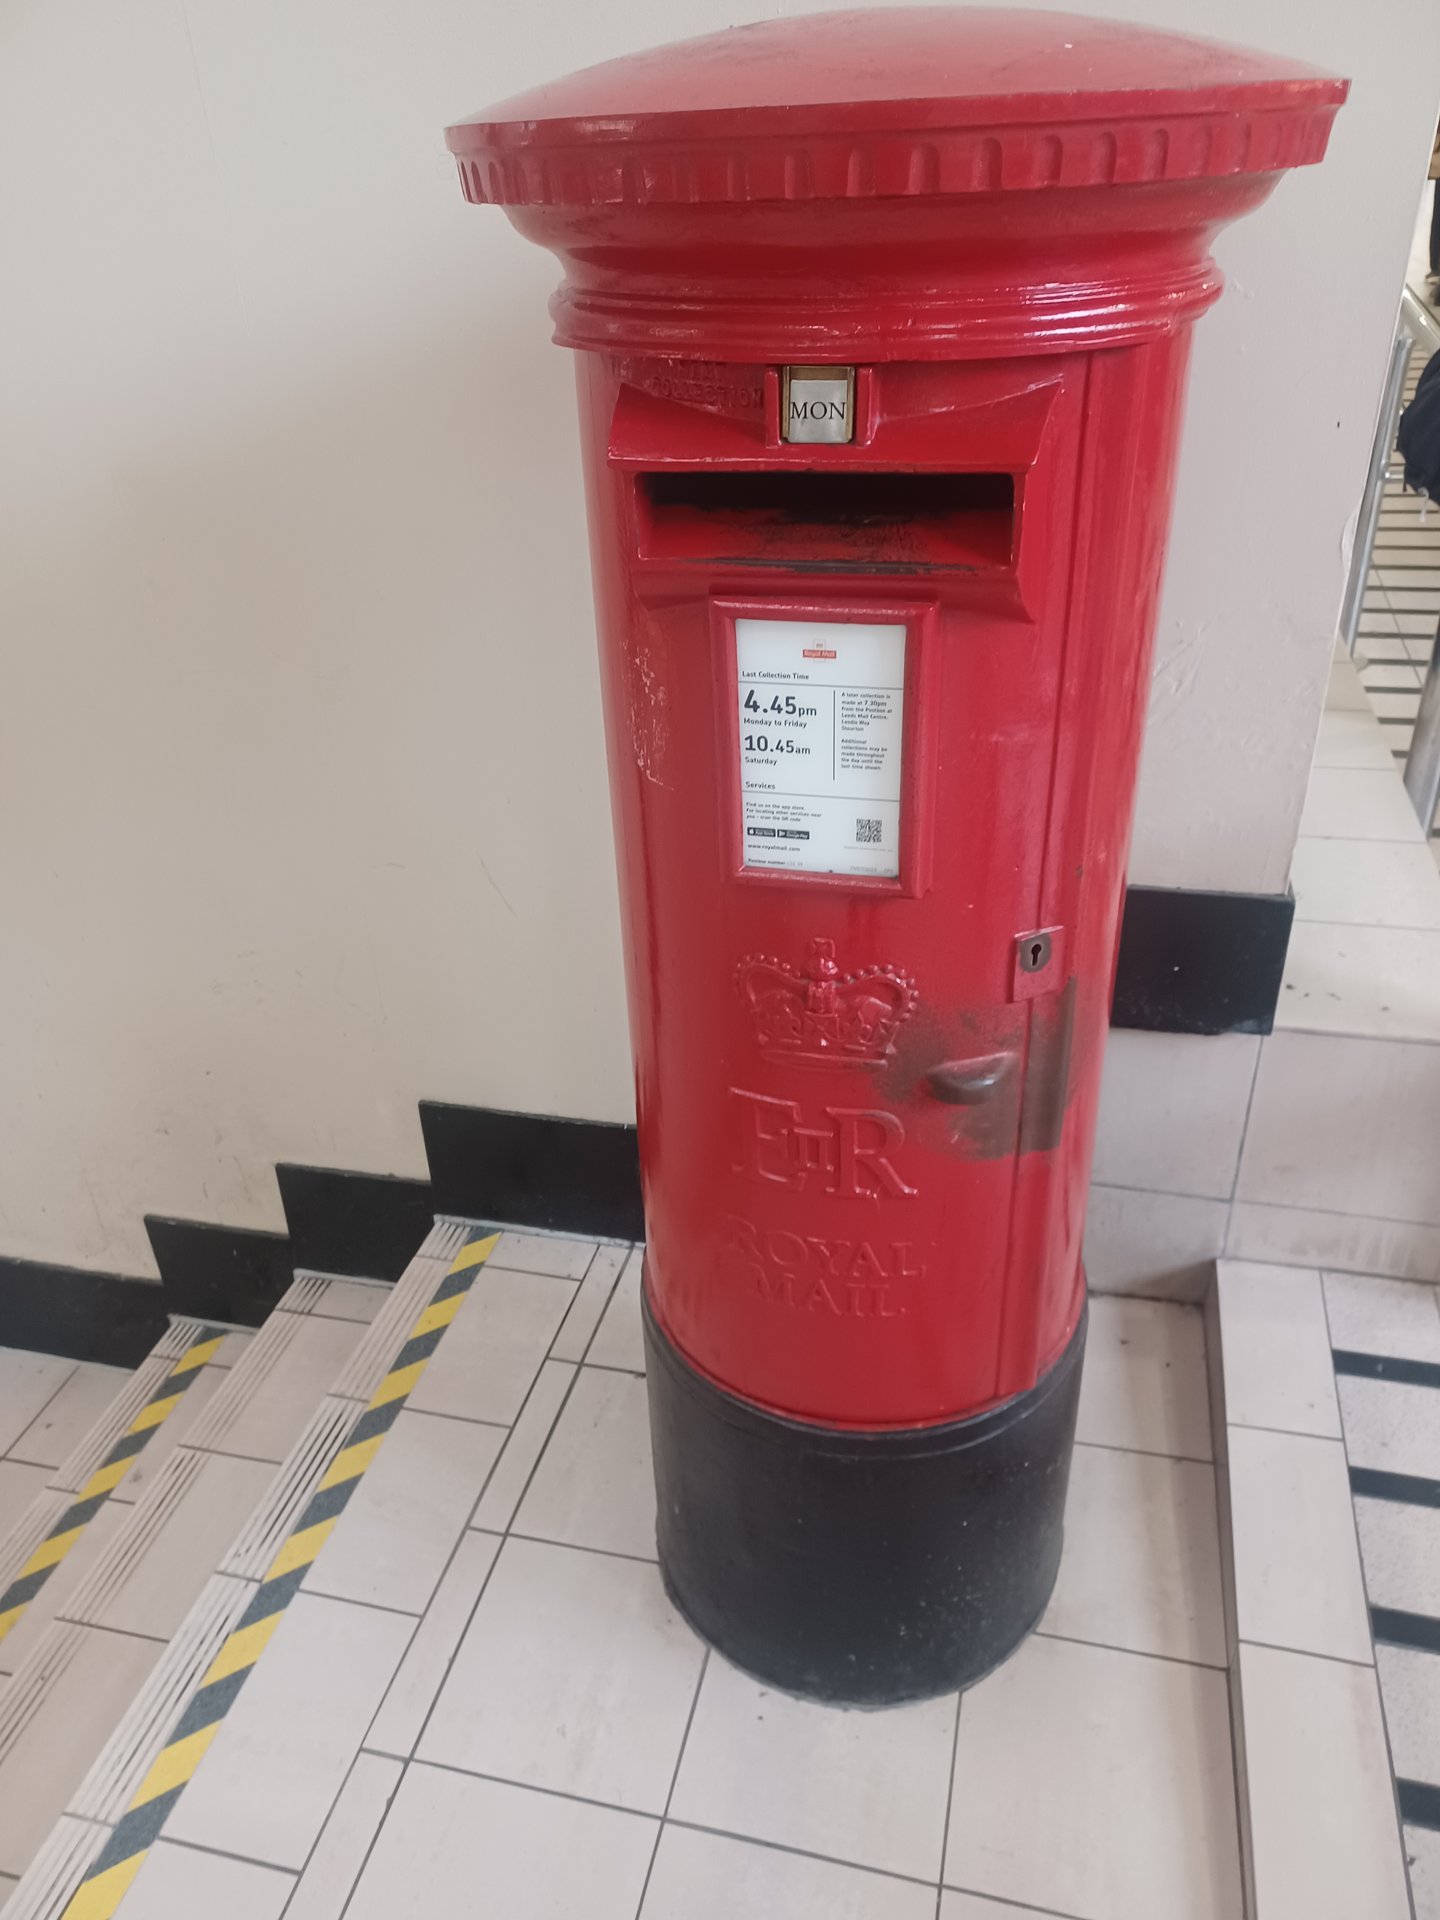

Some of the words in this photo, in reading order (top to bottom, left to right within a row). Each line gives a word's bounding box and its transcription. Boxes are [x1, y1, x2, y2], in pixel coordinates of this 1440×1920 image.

[790, 401, 846, 420] MON
[804, 650, 820, 658] Royal
[822, 650, 835, 658] Mail
[758, 671, 790, 679] Collection
[744, 689, 817, 718] 4.45pm
[743, 717, 772, 727] Monday
[774, 719, 782, 727] to
[784, 719, 807, 729] Friday
[744, 734, 811, 755] 10.45am
[744, 756, 777, 766] Saturday
[745, 780, 776, 790] Services
[747, 844, 800, 852] www.royalmail.com
[727, 1213, 926, 1278] ROYAL
[750, 1263, 907, 1318] MAIL
